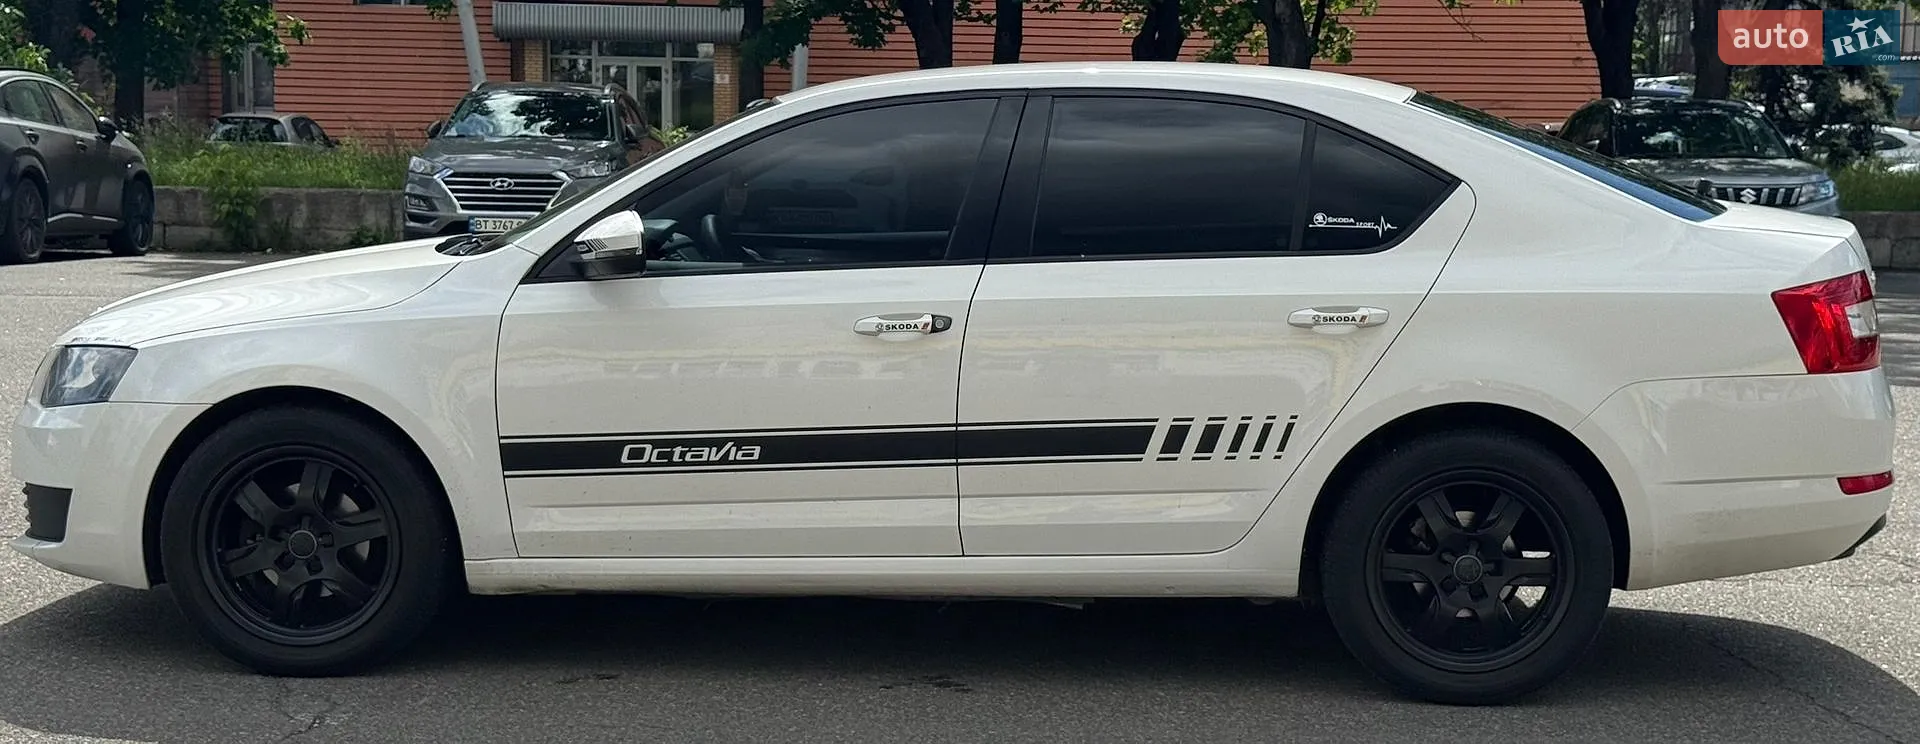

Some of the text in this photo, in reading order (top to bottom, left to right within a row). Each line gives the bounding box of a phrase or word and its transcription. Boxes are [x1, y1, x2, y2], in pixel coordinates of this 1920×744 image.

[475, 219, 489, 230] BT
[492, 220, 514, 231] 3767
[1322, 315, 1357, 323] SKODA
[885, 323, 919, 331] SKODA
[621, 441, 761, 464] Octavia
